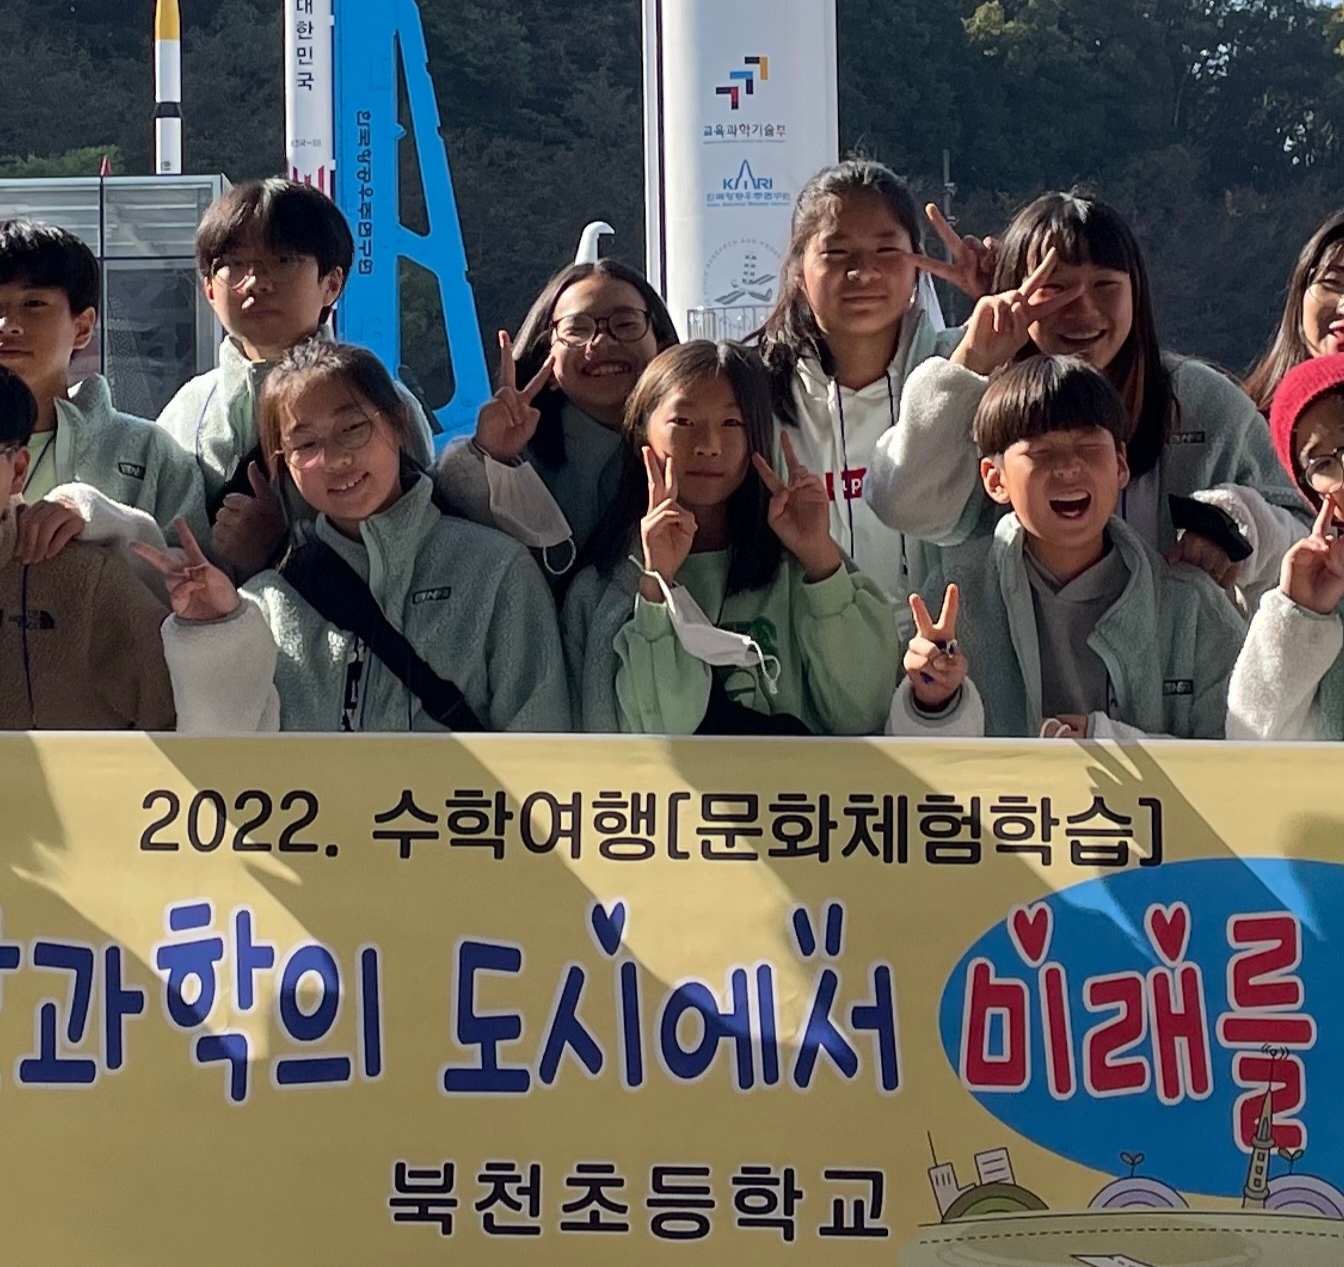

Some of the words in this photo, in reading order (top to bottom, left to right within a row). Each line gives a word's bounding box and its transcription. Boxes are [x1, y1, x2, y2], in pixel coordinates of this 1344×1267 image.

[703, 123, 787, 138] 교육과학기술부
[356, 110, 374, 275] 한국항공우주연구원
[722, 159, 773, 190] KARI
[140, 789, 339, 858] 2022.
[444, 900, 902, 1094] 도시에서
[965, 906, 1316, 1151] 미래를
[389, 1161, 890, 1242] 북천초등학교
